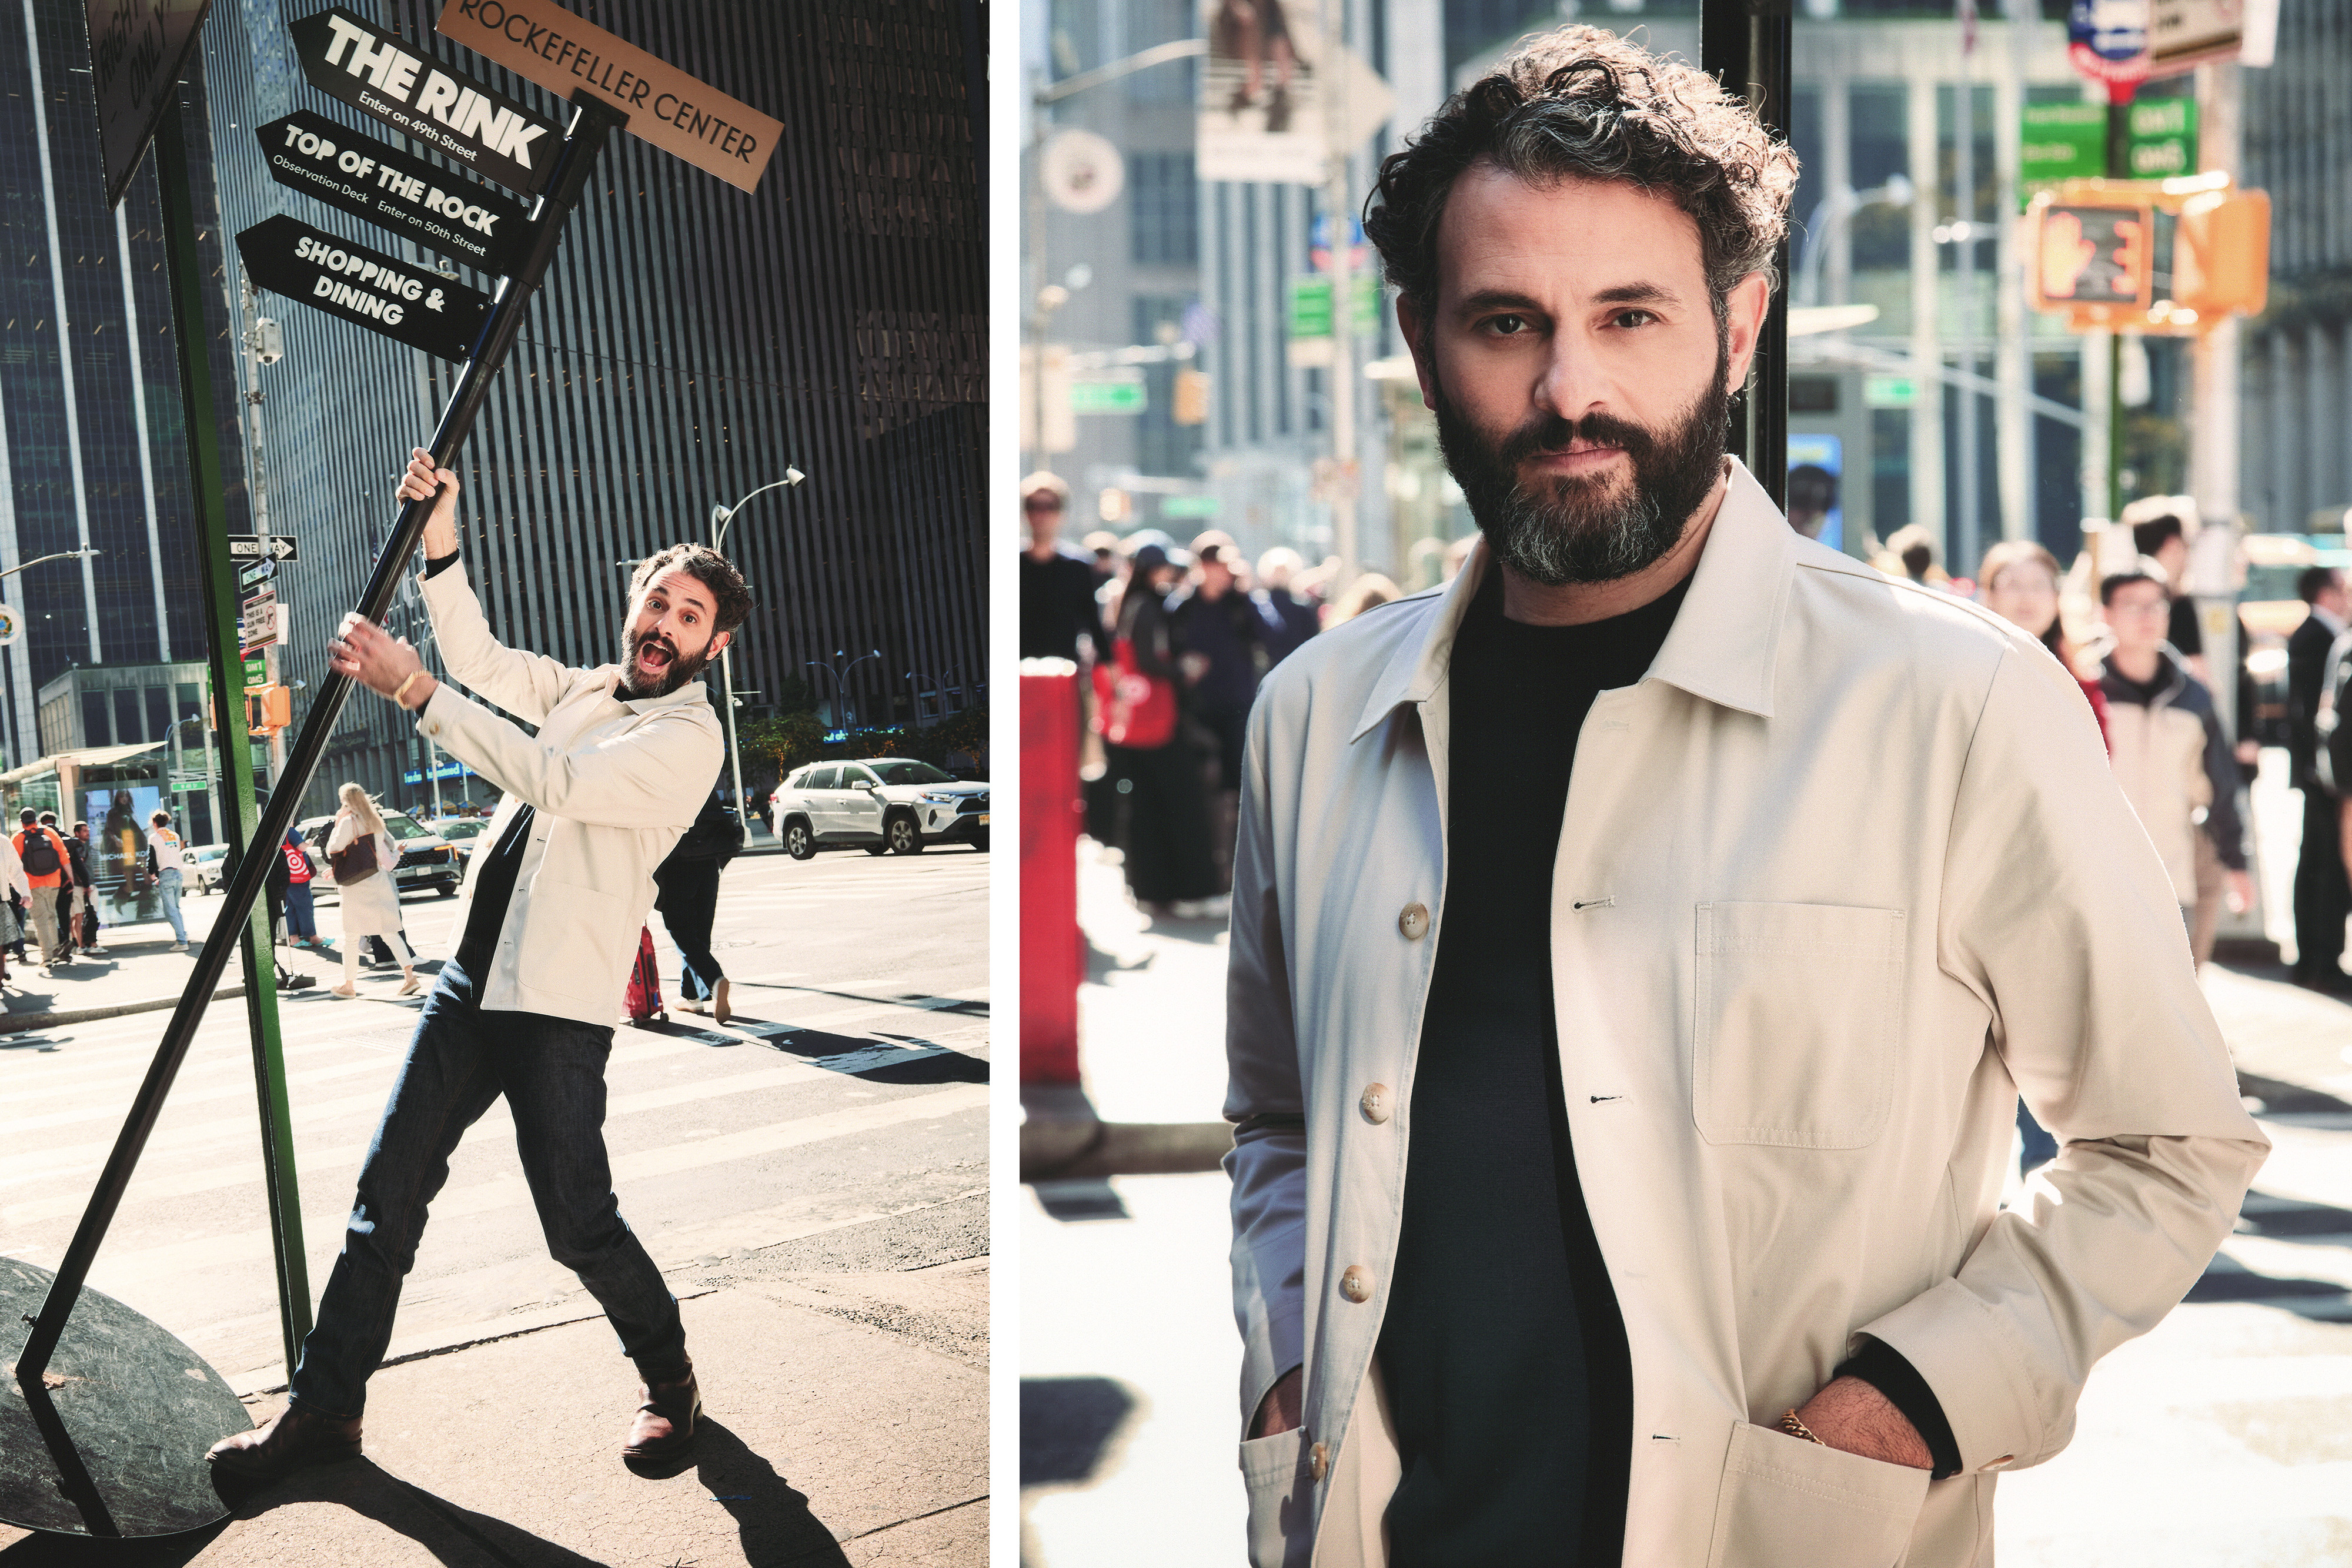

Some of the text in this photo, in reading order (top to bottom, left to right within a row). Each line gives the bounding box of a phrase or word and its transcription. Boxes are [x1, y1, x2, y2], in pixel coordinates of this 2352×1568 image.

[324, 14, 548, 170] THE RINK
[459, 0, 756, 163] ROCKEFELLER CENTER
[359, 91, 477, 162] Enter on 49th Street
[273, 155, 486, 256] Observation Deck Enter on 50th Street
[285, 123, 500, 237] TOP OF THE ROCK
[295, 236, 445, 313] SHOPPING &
[313, 275, 404, 325] DINING
[236, 543, 258, 553] ONE
